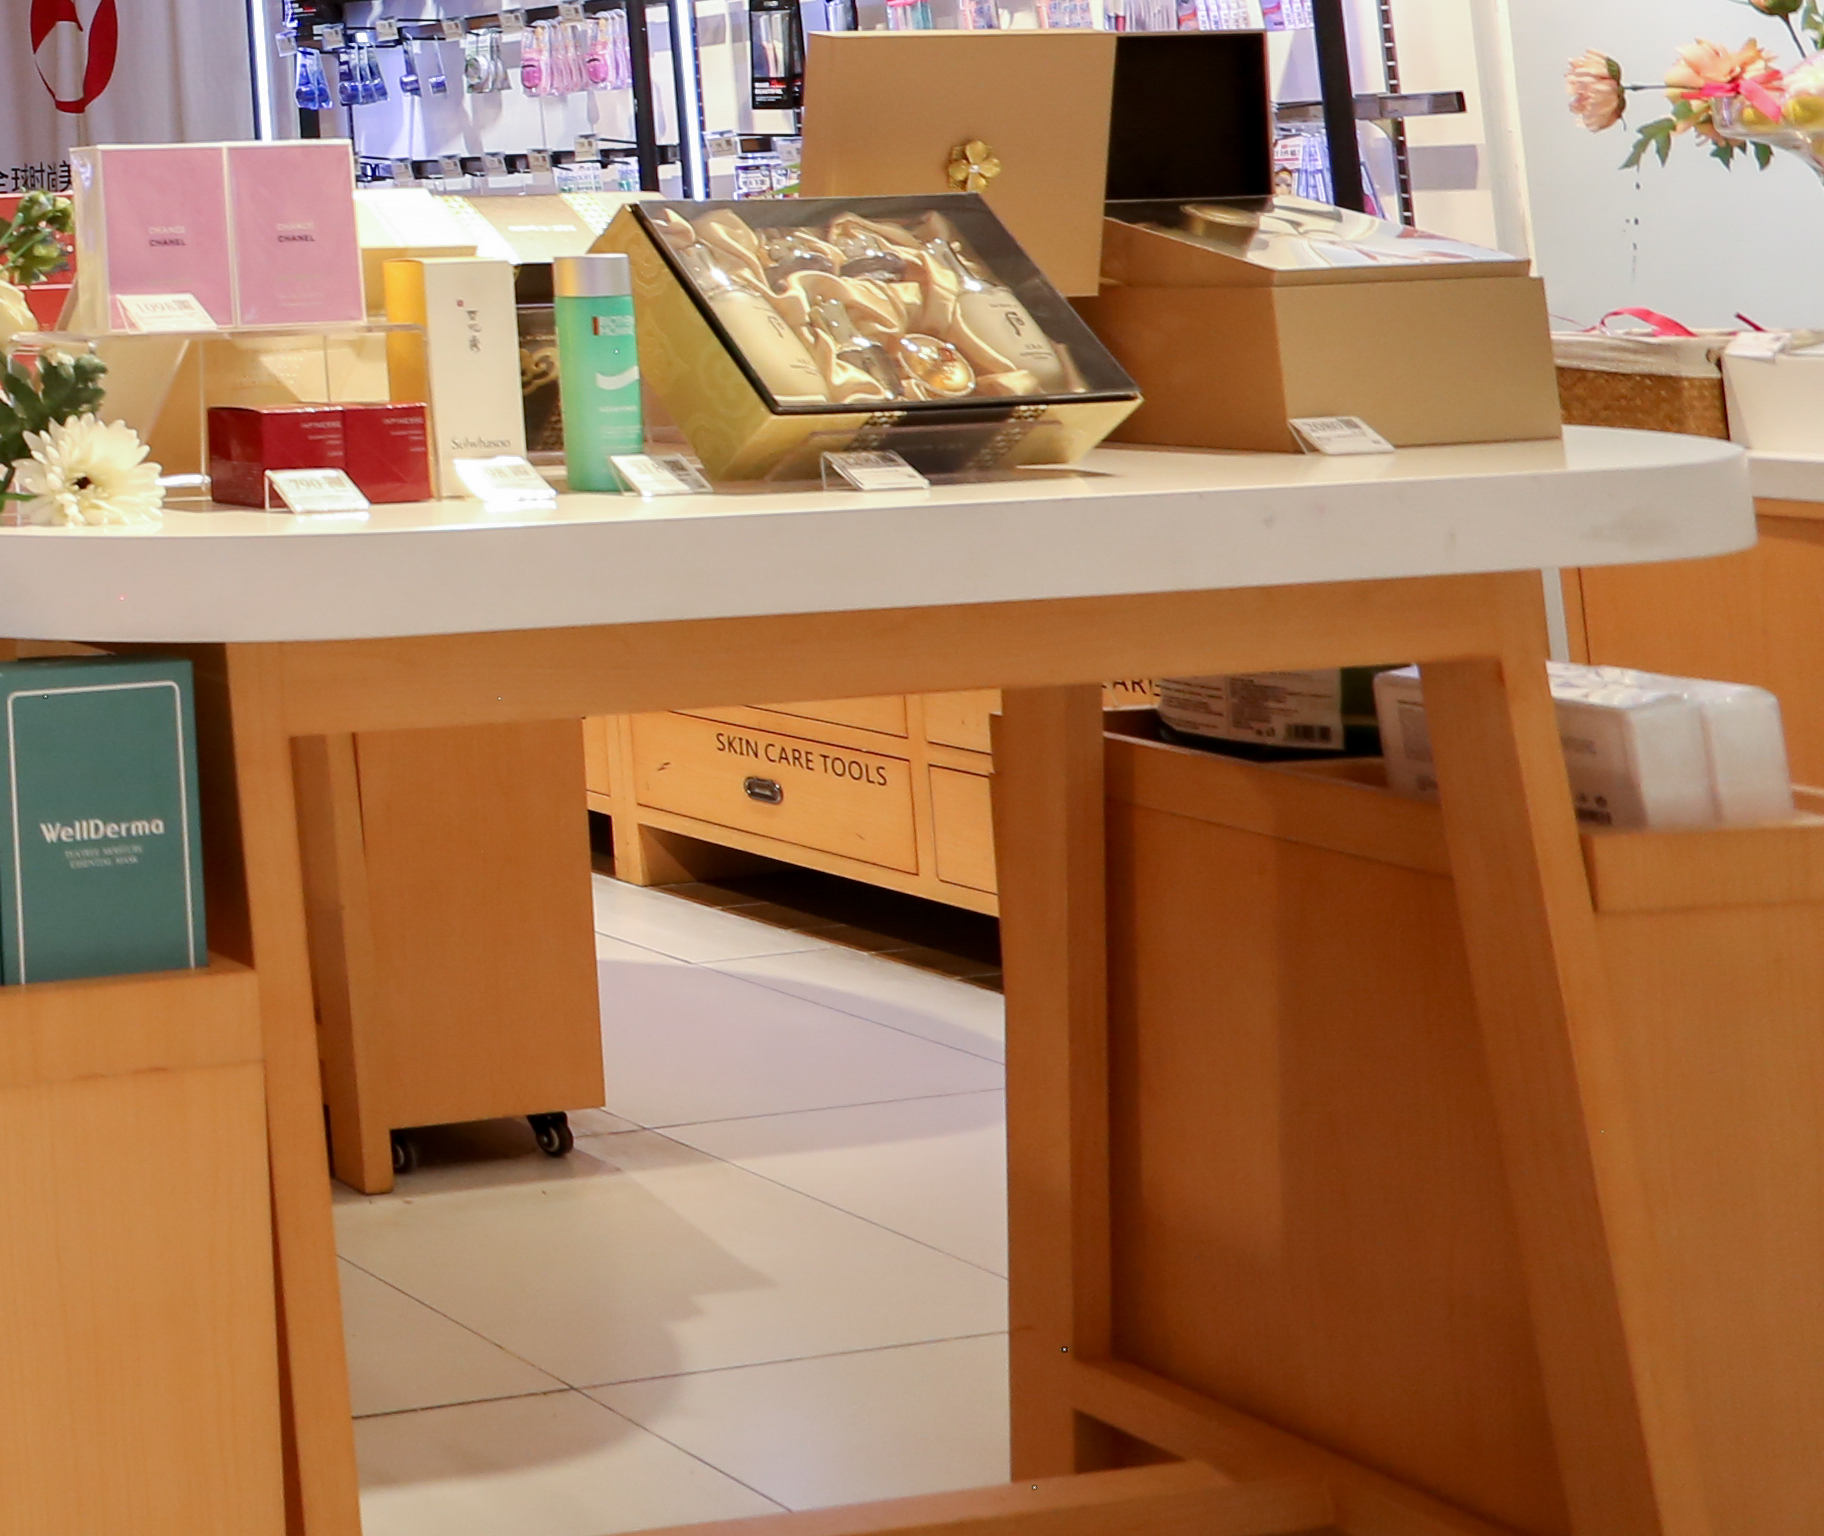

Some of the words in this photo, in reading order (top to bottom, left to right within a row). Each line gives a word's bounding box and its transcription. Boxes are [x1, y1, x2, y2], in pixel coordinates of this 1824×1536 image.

[149, 238, 187, 247] CHANEL
[277, 234, 316, 244] CHANEL
[136, 301, 175, 312] 1098
[715, 732, 759, 759] SKIN
[764, 743, 814, 771] CARE
[820, 754, 889, 787] TOOLS
[40, 818, 165, 844] WellDerma
[65, 847, 99, 859] TEATREE
[102, 844, 143, 856] MOISTURE
[69, 858, 112, 870] ESSENTIAL
[116, 855, 139, 866] MASK
